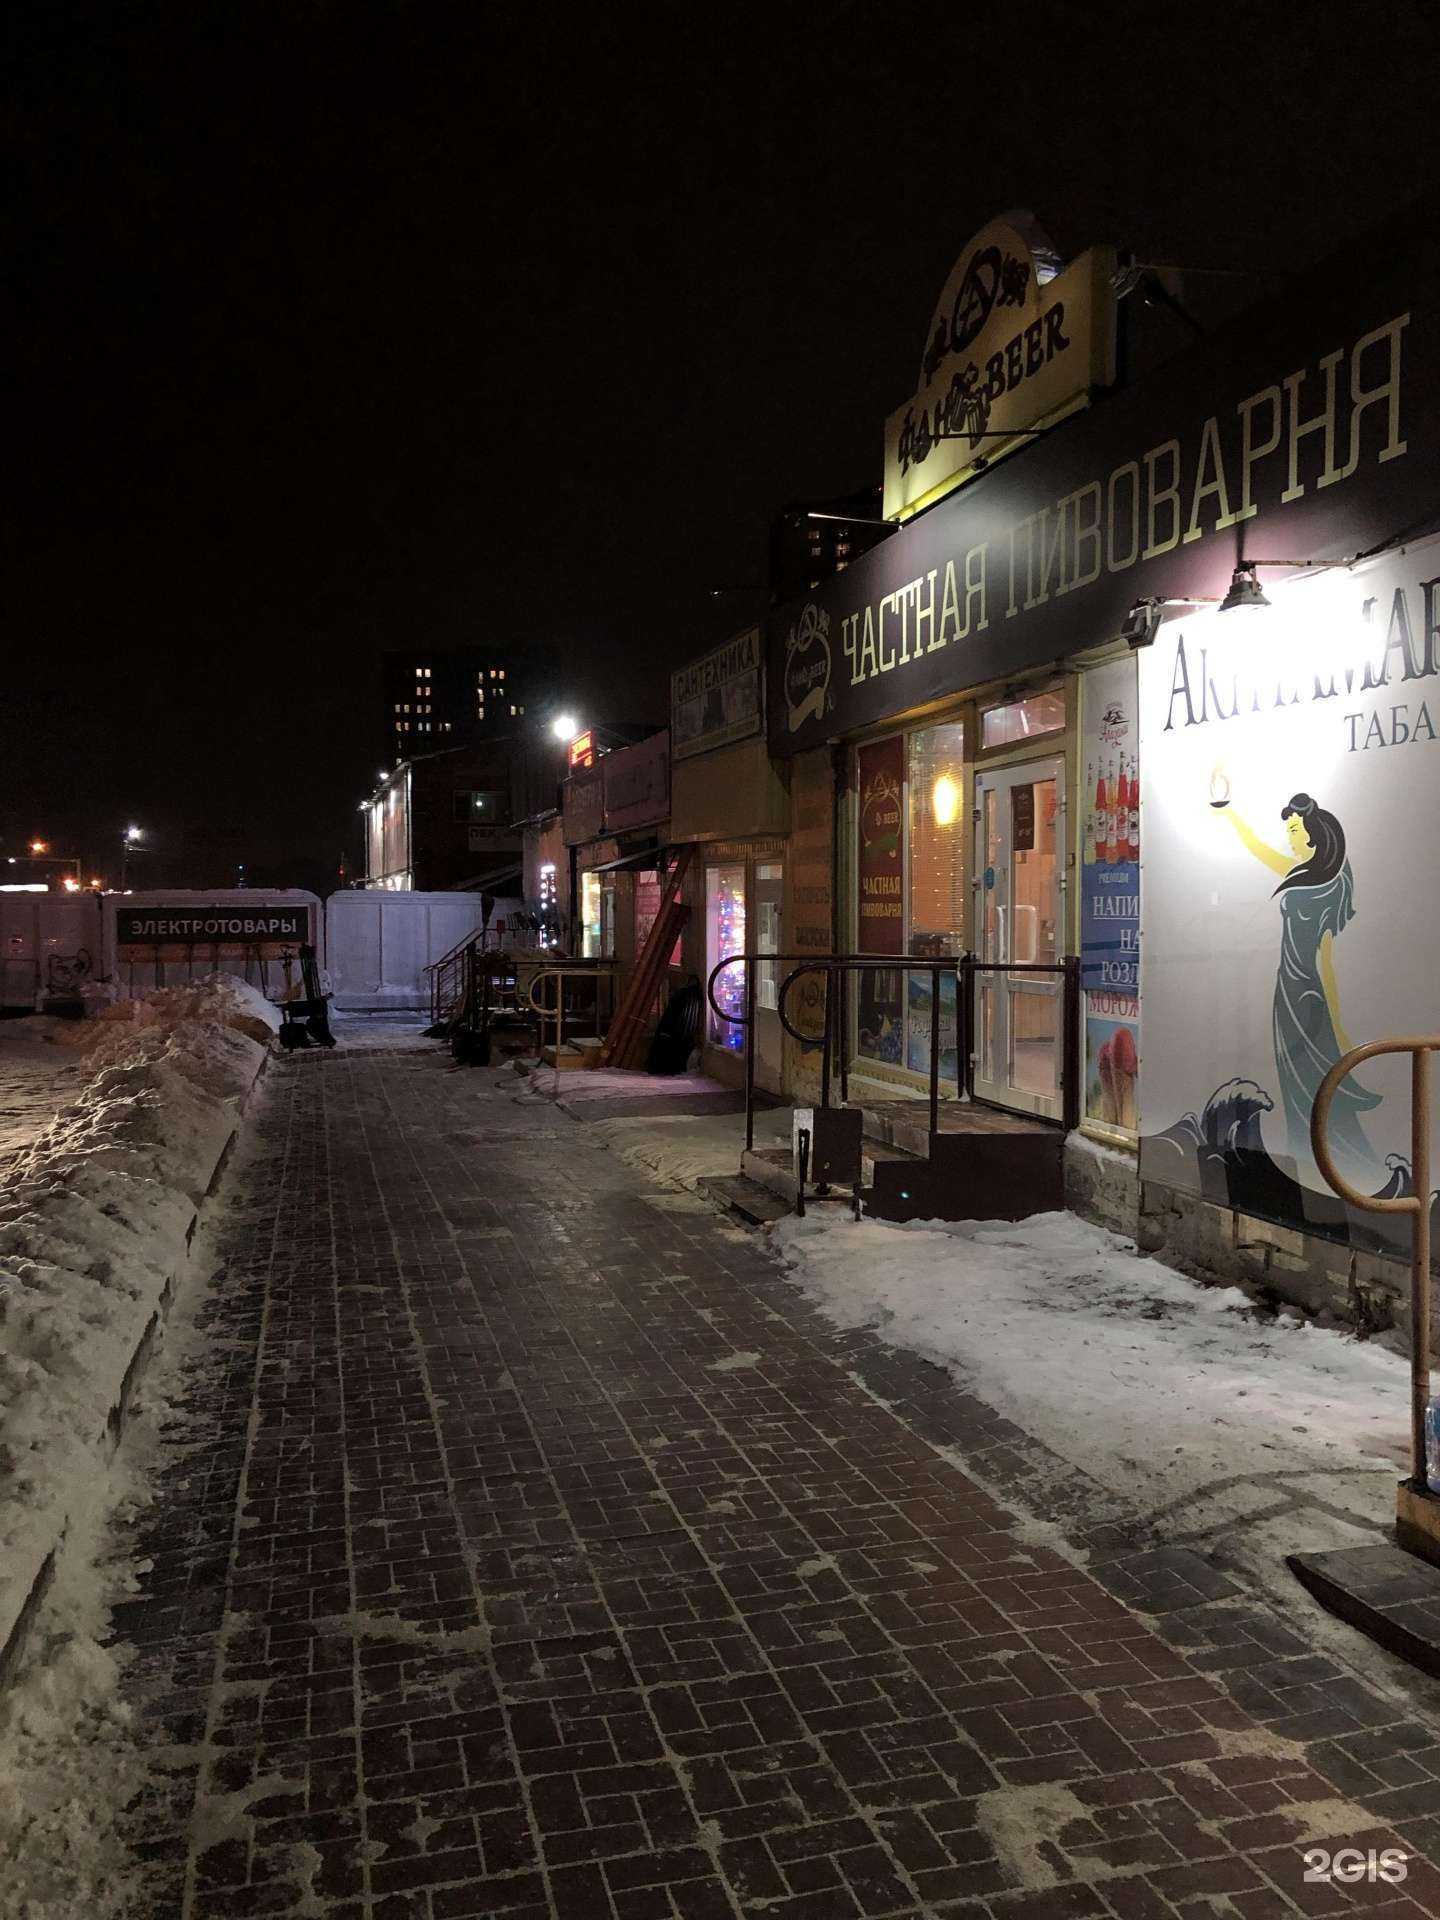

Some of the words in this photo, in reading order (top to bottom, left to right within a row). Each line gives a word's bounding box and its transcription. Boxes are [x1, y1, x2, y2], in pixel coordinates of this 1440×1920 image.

[986, 302, 1070, 400] BEER
[842, 542, 989, 686] ЧАСТНАЯ
[1002, 313, 1411, 619] ПИВОВАРНЯ
[1344, 701, 1437, 752] ТАБА
[130, 919, 297, 935] ЭЛЕКТРОТОВАРЫ
